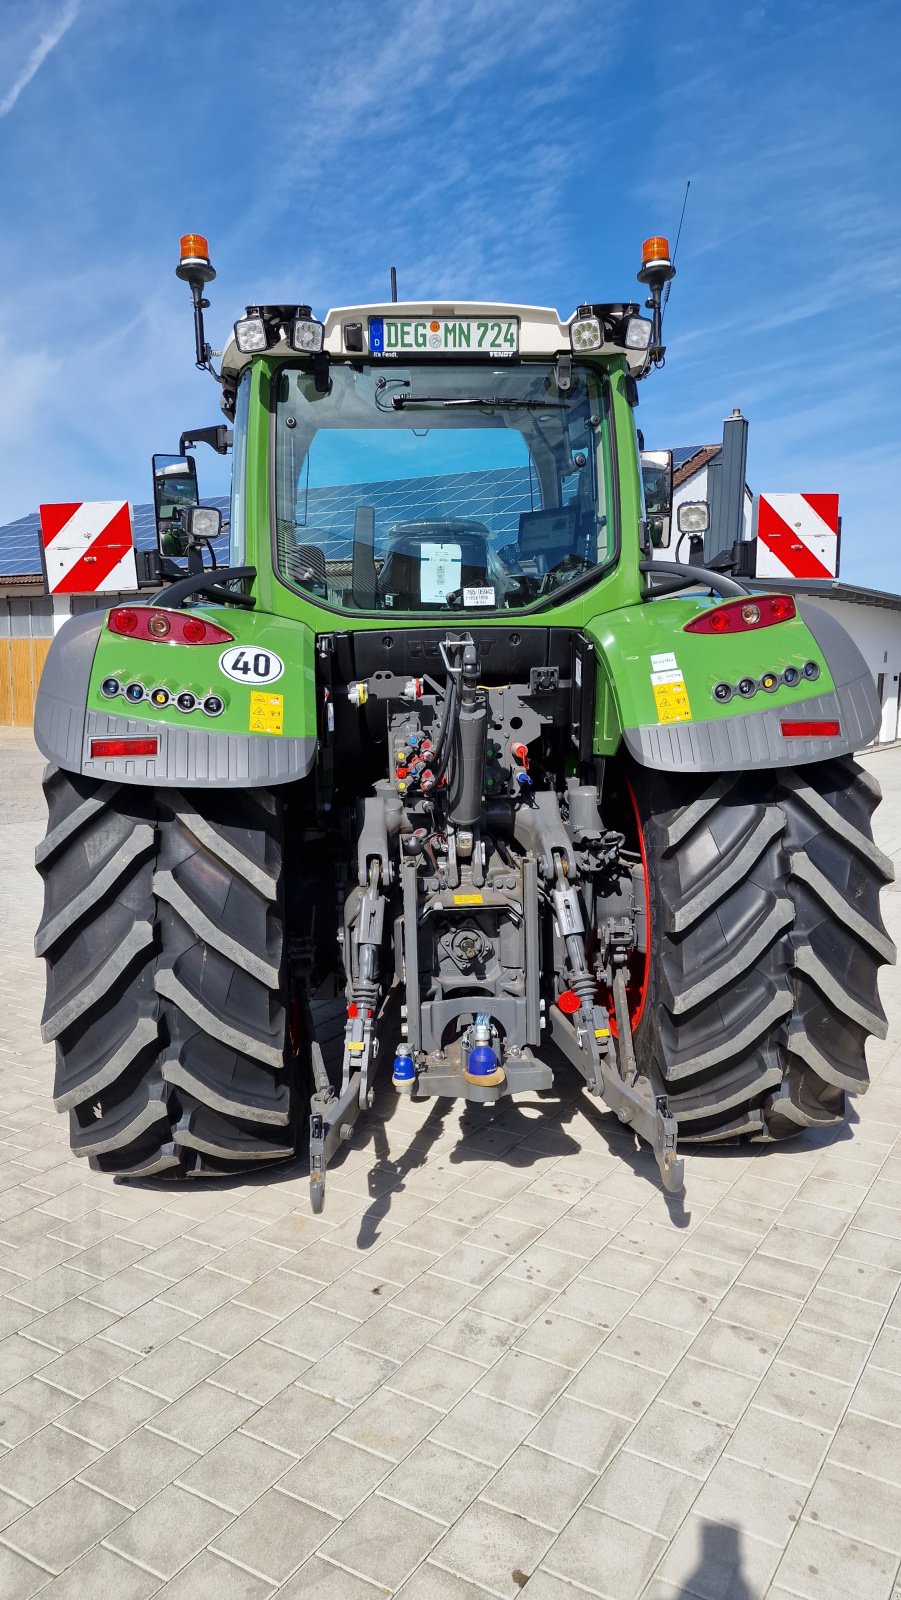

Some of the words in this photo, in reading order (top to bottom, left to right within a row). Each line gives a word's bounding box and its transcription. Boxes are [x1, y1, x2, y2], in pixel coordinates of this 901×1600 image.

[386, 323, 427, 347] DEG
[444, 323, 470, 347] MN
[477, 323, 515, 347] 724
[406, 639, 496, 658] FET
[231, 651, 271, 677] 40
